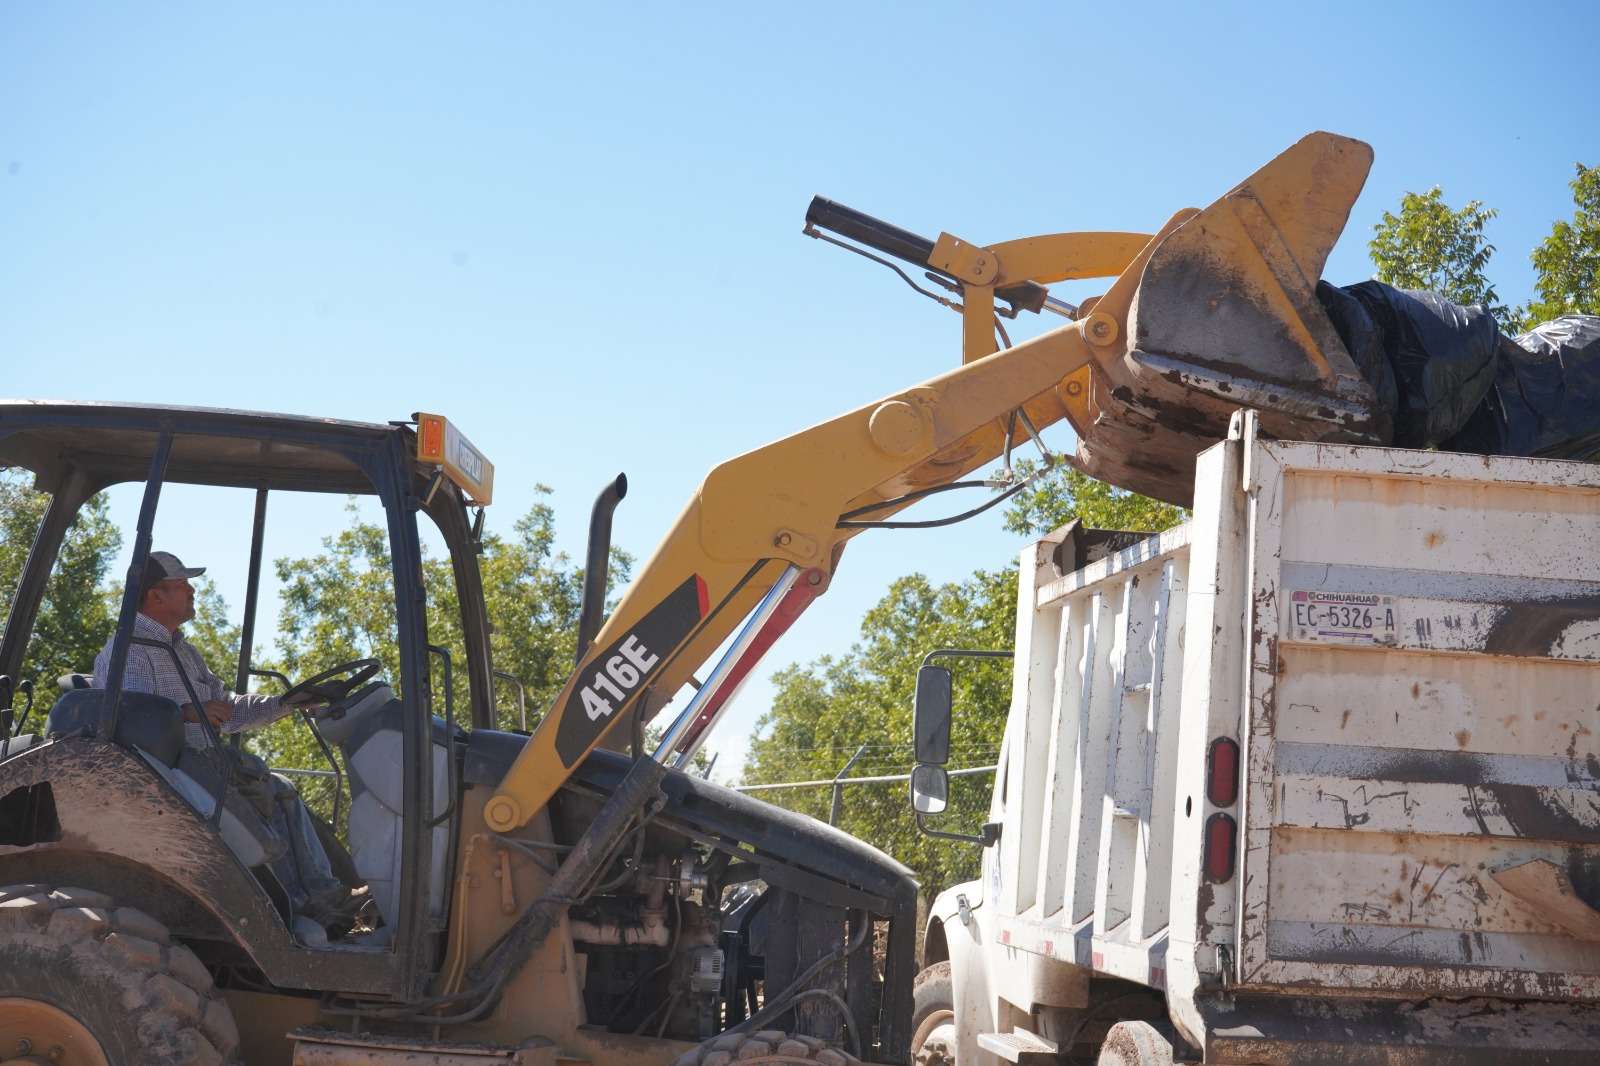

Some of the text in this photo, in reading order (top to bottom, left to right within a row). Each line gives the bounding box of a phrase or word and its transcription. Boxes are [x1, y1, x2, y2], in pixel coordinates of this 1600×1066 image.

[1316, 593, 1373, 603] CHIHUAHUA
[1296, 604, 1394, 631] EC-5326-A
[580, 634, 660, 721] 416E
